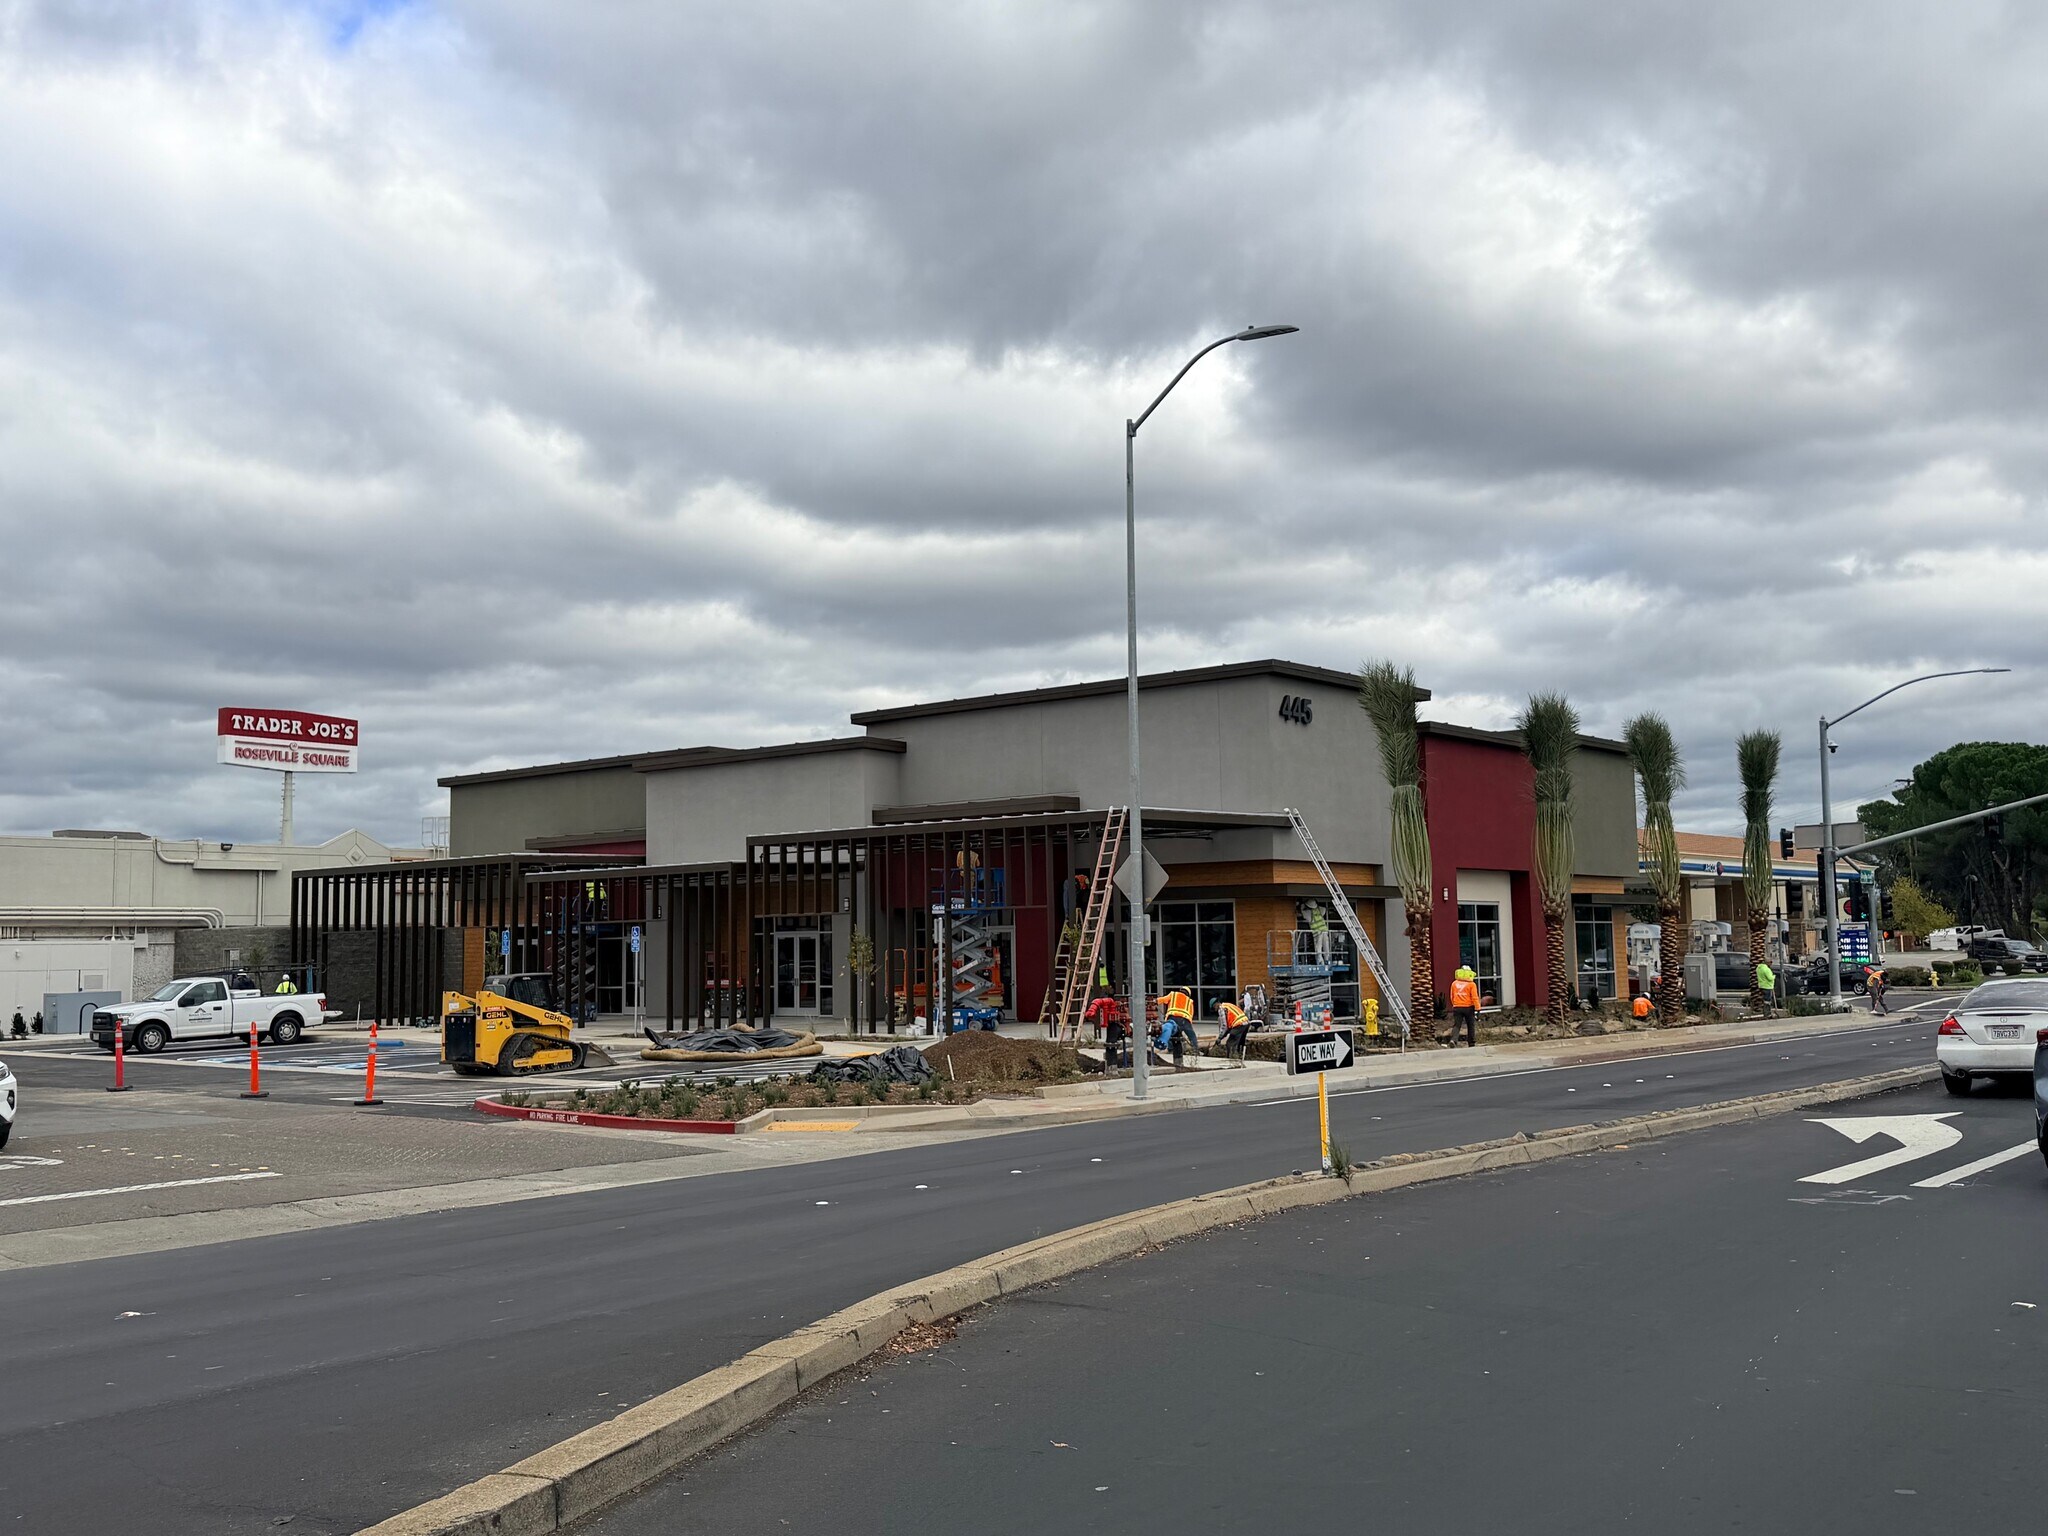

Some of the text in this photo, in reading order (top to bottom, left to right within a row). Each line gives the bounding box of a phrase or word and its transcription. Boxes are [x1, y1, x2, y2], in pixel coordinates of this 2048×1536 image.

[1279, 694, 1313, 725] 445
[231, 714, 356, 740] TRADER JOE'S
[234, 746, 350, 767] ROSEVILLE SQUARE
[486, 1011, 507, 1019] GEHL
[544, 1011, 564, 1023] GEHL
[1300, 1043, 1335, 1061] ONE WAY
[536, 1111, 554, 1121] PARKING
[555, 1113, 566, 1122] FIRE
[566, 1114, 579, 1123] LANE
